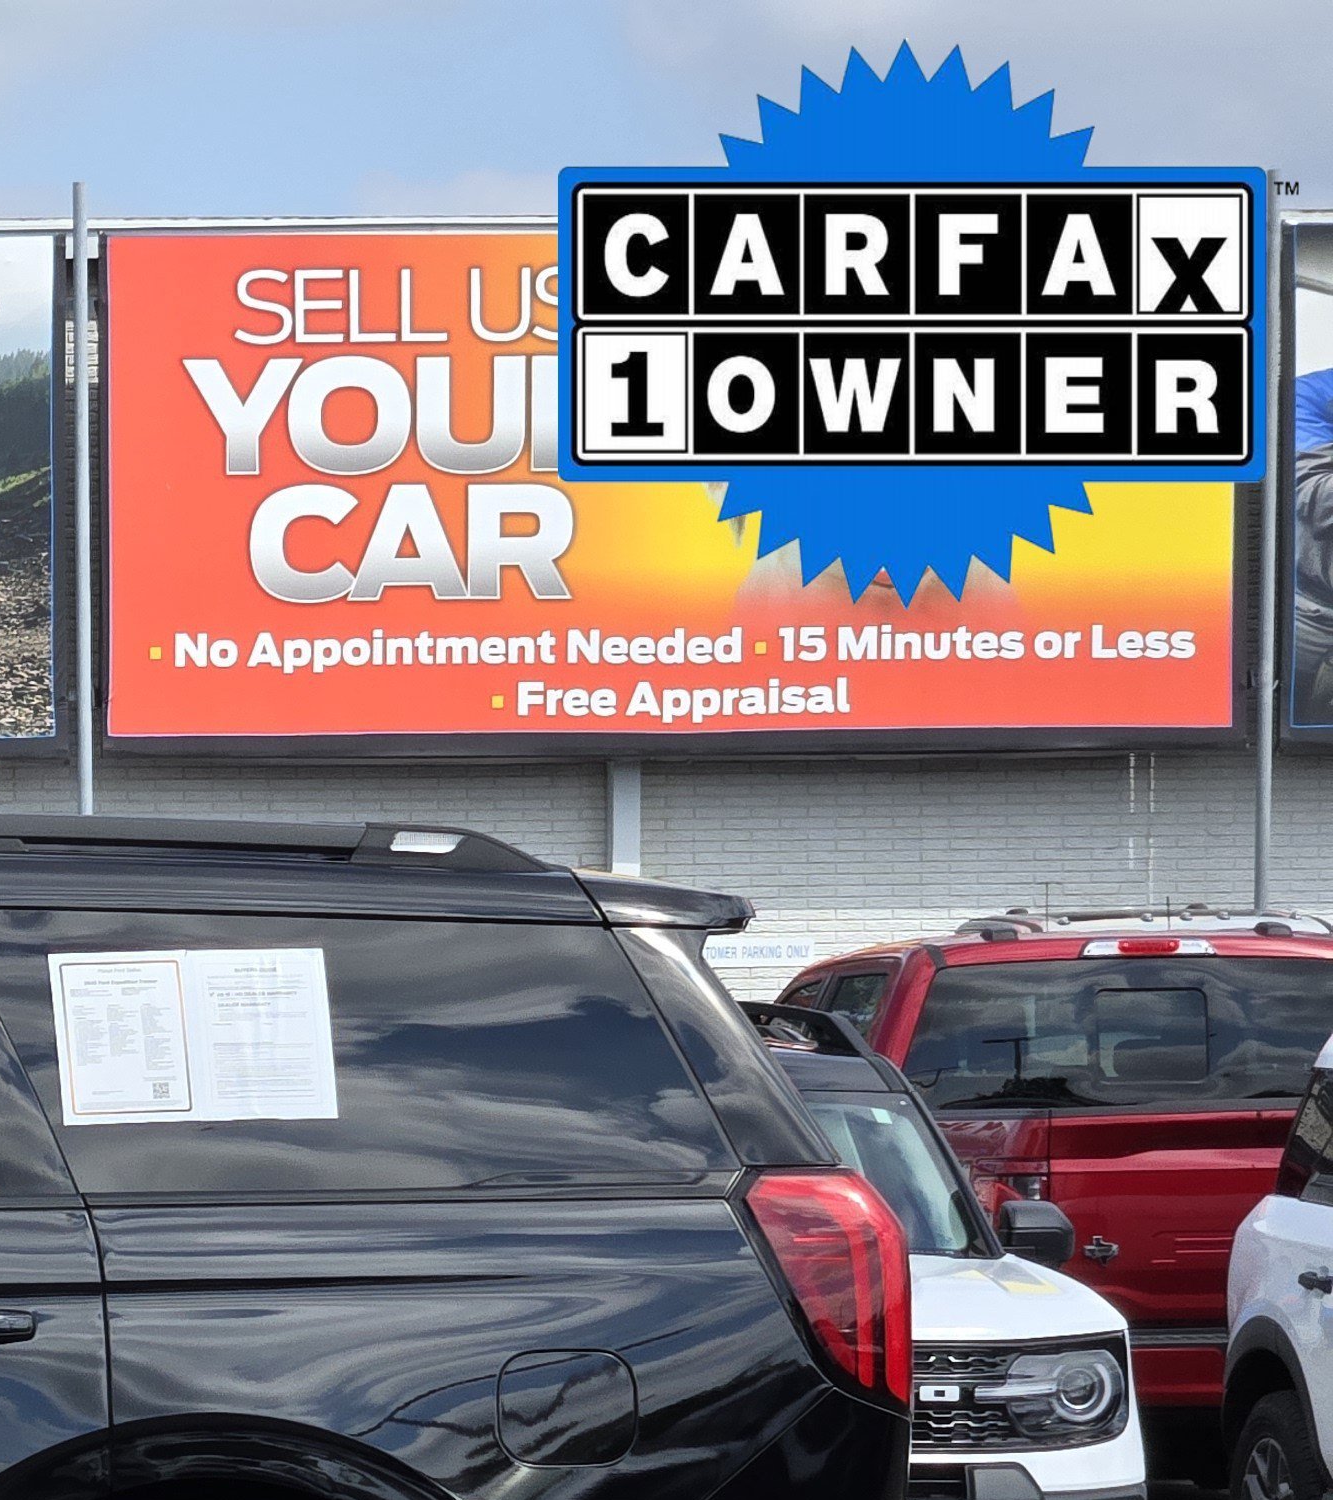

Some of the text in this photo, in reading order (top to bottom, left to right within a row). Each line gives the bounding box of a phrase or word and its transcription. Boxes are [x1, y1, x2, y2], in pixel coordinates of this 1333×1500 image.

[233, 266, 448, 345] SELL
[248, 482, 575, 605] CAR
[173, 624, 1197, 675] No Appointment Needed 15 Minutes or Less
[516, 675, 852, 725] Free Appraisal
[741, 944, 782, 959] PARKING
[786, 944, 810, 959] ONLY
